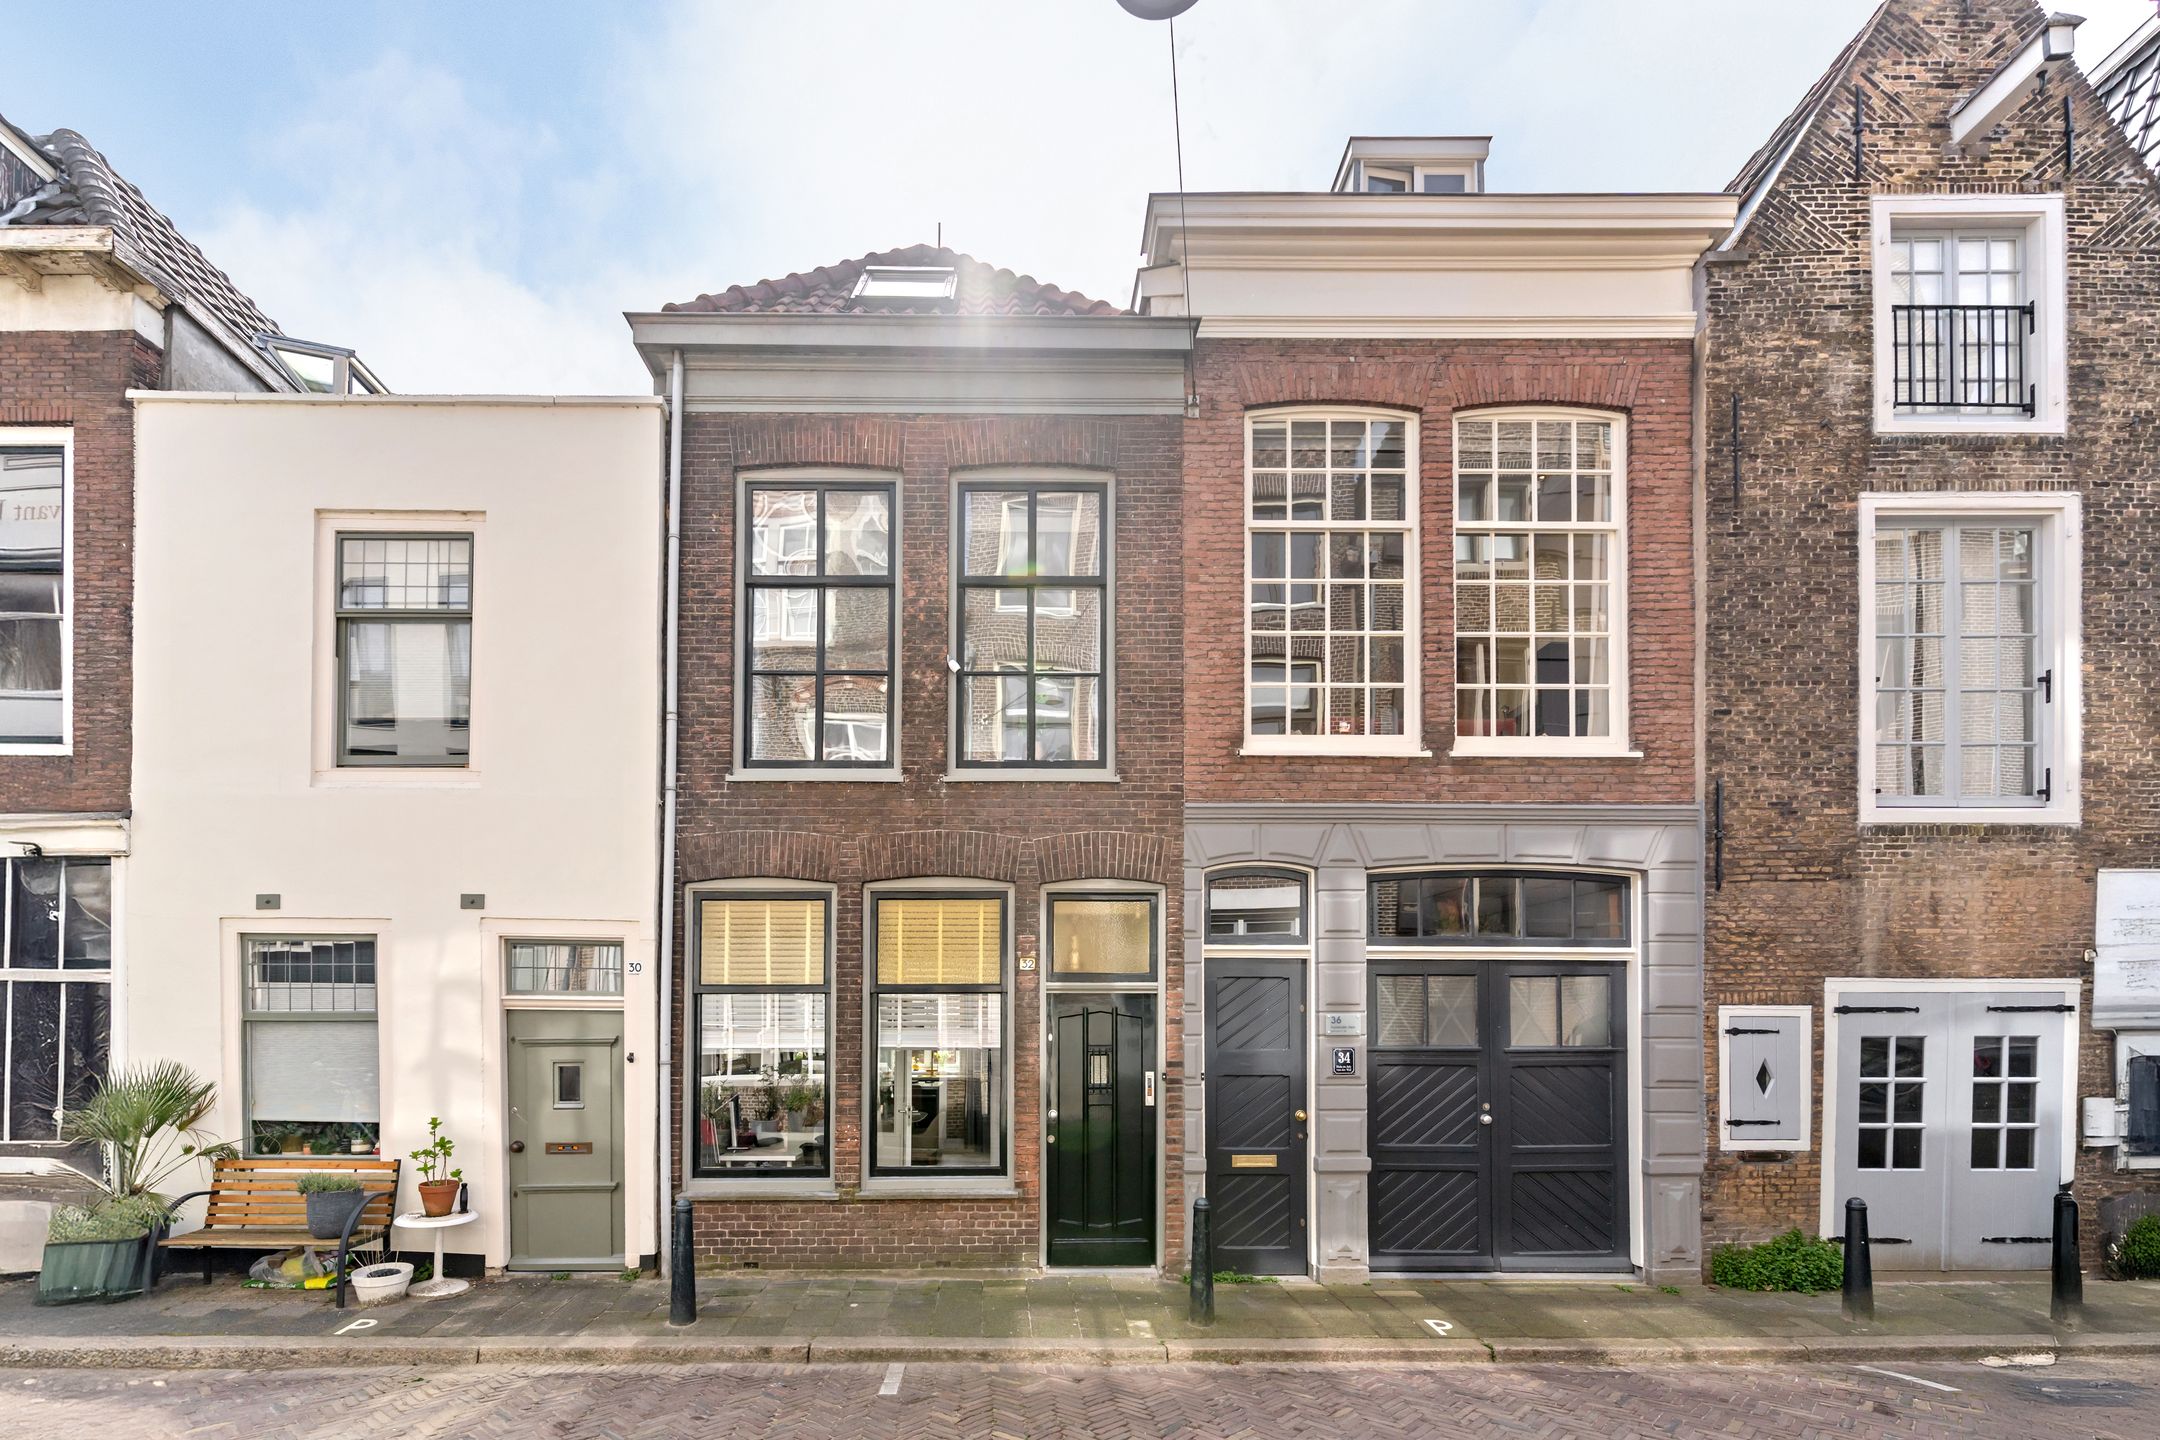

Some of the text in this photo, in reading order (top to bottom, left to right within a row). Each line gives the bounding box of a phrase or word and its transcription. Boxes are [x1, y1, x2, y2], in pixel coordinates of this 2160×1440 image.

[629, 962, 642, 973] 30
[1021, 959, 1035, 969] 32
[1331, 1016, 1342, 1024] 36
[1338, 1052, 1351, 1064] 34
[333, 1319, 378, 1335] P
[1423, 1319, 1453, 1336] P
